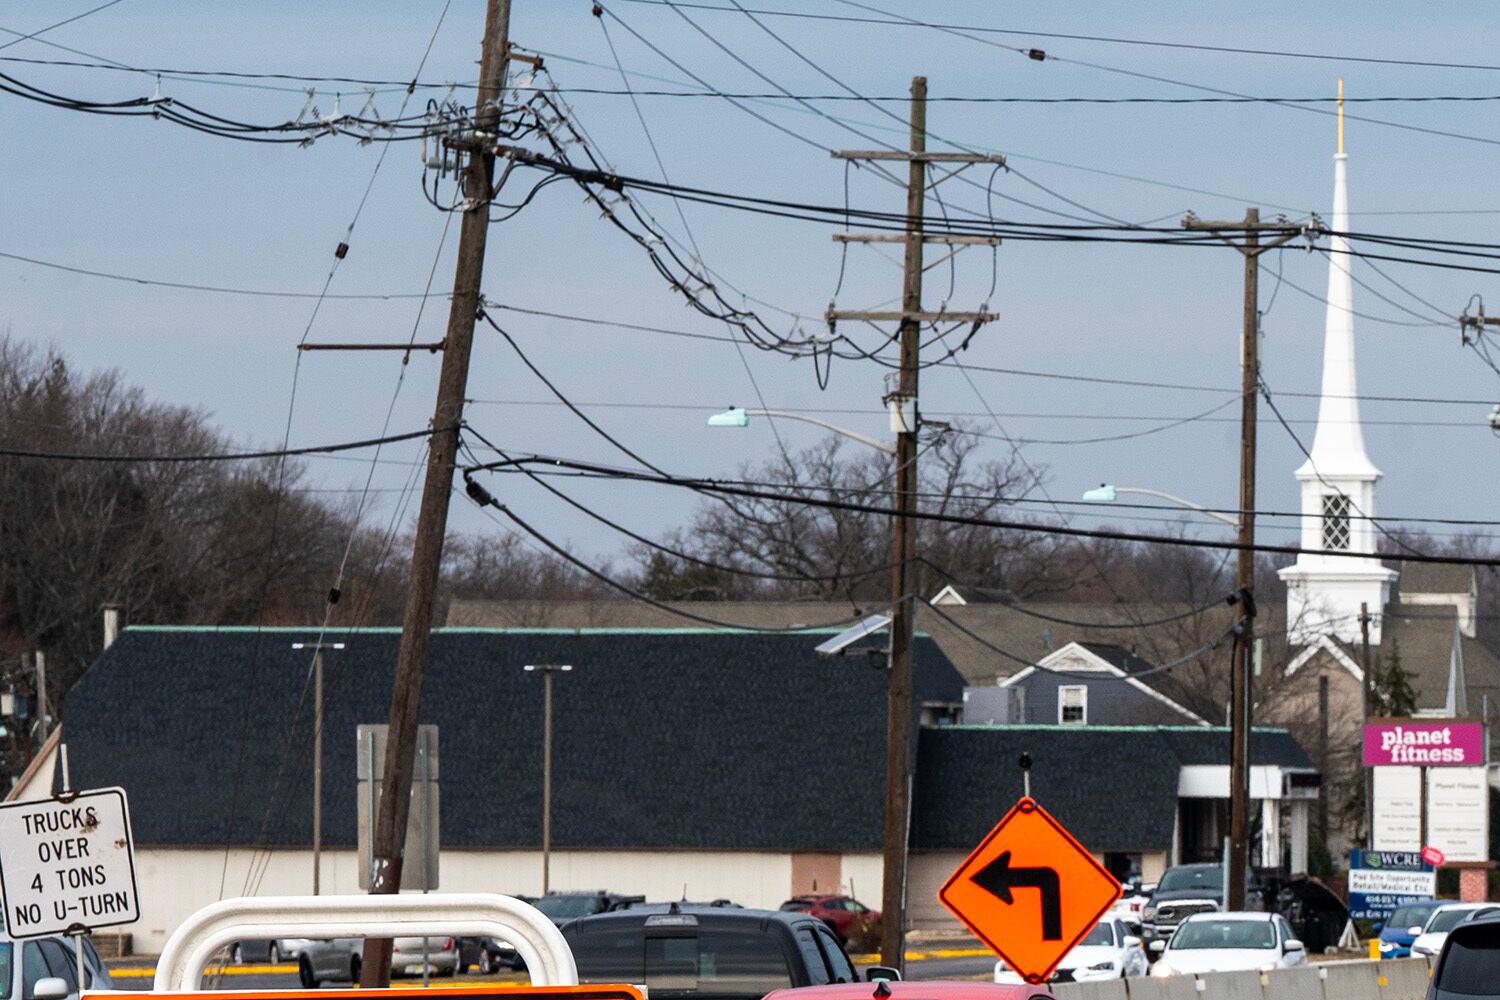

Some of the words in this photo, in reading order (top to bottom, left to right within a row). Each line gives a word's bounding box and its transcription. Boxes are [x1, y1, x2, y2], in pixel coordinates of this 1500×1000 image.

[1381, 726, 1451, 750] planet
[1391, 744, 1464, 762] fitness
[22, 806, 98, 835] TRUCKS
[38, 837, 90, 863] OVER
[1381, 852, 1421, 865] WCRE
[31, 873, 43, 893] 4
[56, 865, 106, 890] TONS
[15, 904, 41, 926] NO
[54, 891, 129, 921] U-TURN
